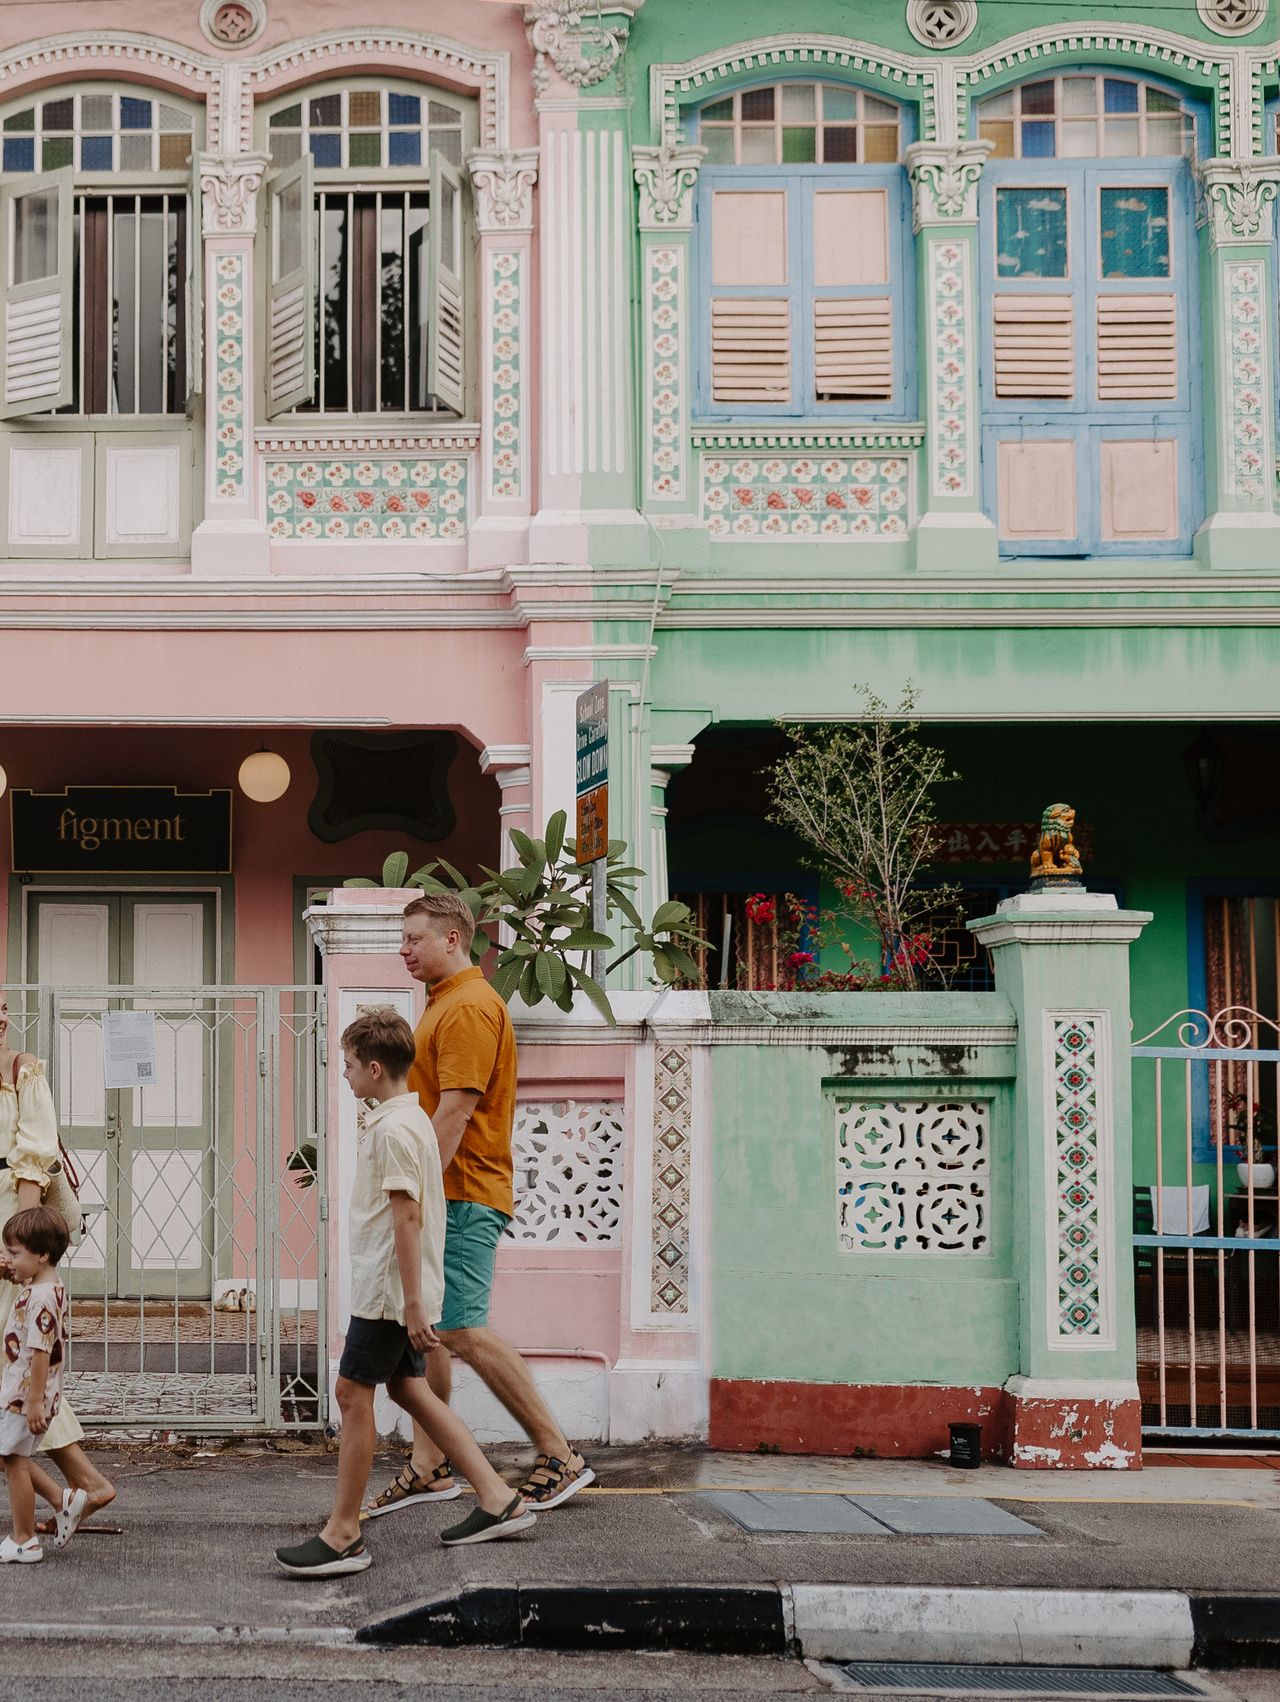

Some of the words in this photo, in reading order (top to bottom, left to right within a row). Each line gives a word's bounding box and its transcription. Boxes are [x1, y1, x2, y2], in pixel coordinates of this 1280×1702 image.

[580, 698, 593, 723] School
[595, 695, 605, 714] Zone
[577, 731, 588, 752] Drive
[589, 717, 608, 744] Carefully
[577, 753, 591, 784] SLOW
[592, 743, 608, 776] DOWN
[57, 808, 186, 850] figment
[948, 830, 1041, 853] 出入平
[21, 876, 31, 884] 15
